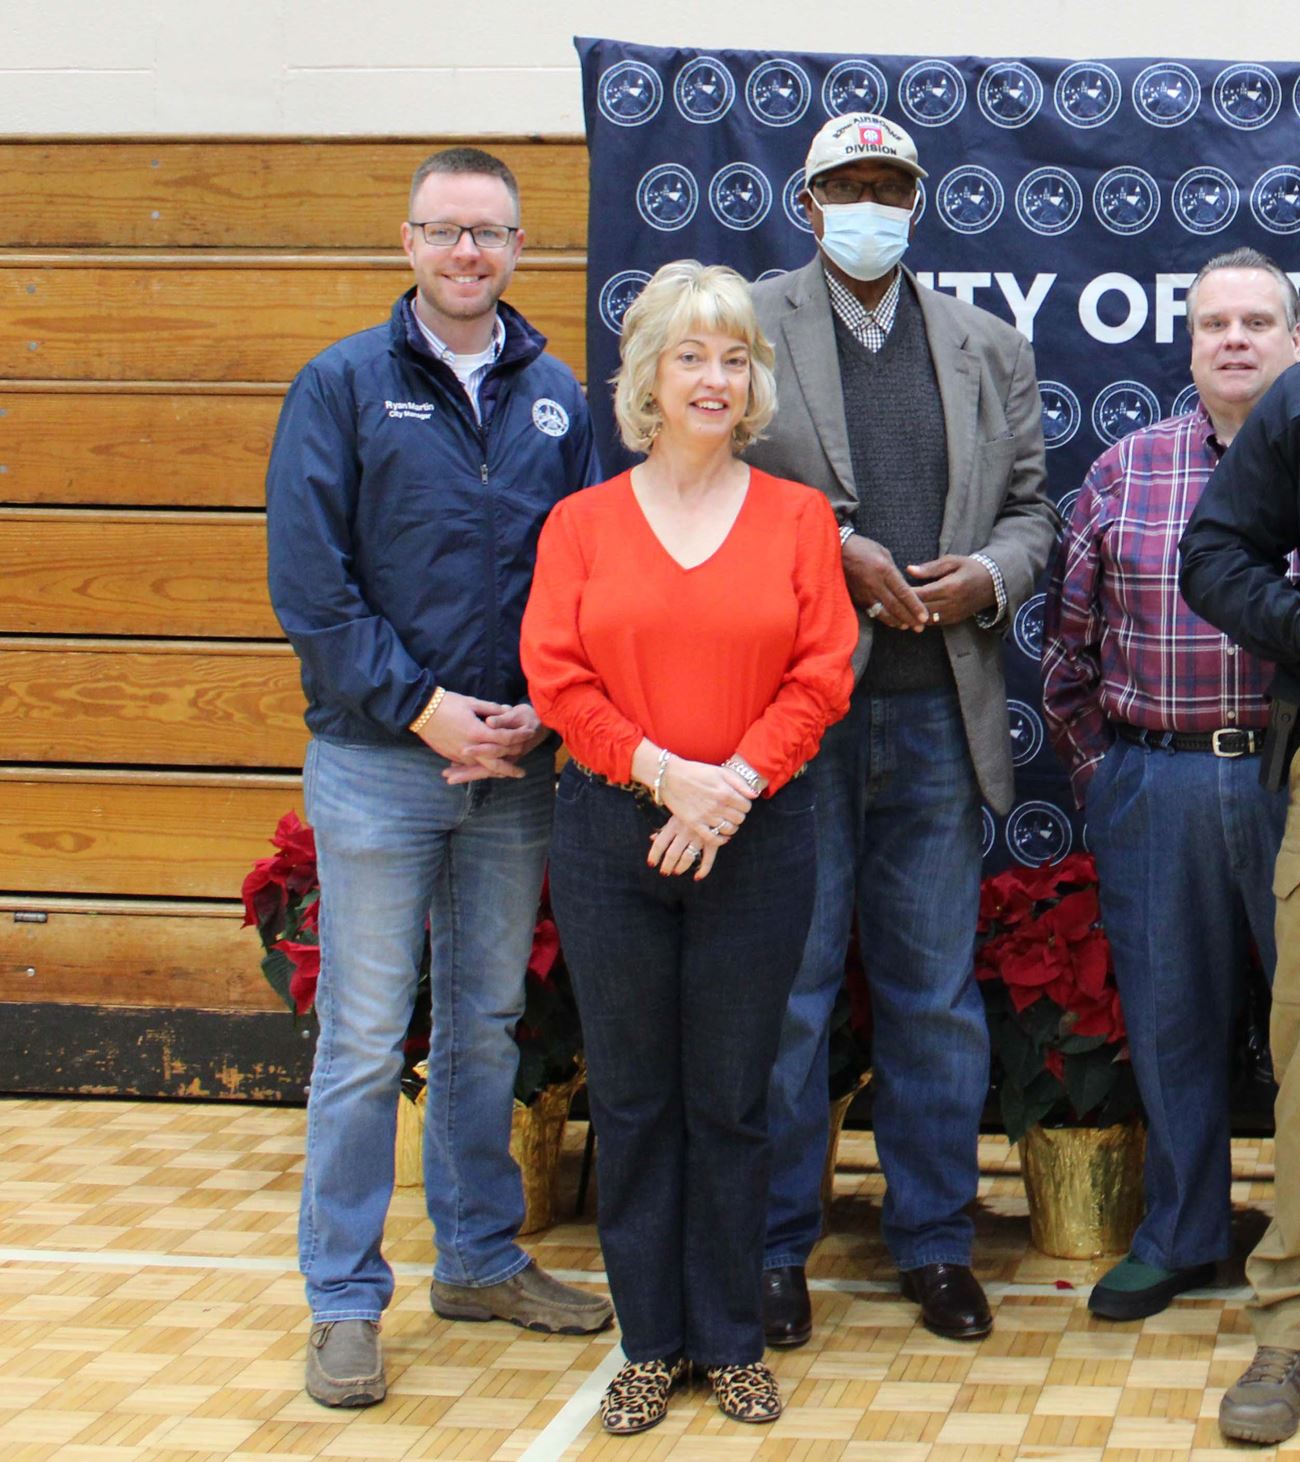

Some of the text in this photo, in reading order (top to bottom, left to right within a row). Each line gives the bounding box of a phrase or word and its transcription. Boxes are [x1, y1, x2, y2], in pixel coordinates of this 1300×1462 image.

[845, 144, 897, 155] DIVISION
[916, 271, 1057, 343] TY
[1078, 271, 1199, 344] OF
[385, 400, 434, 411] Ryan Martin
[404, 411, 431, 420] Manager
